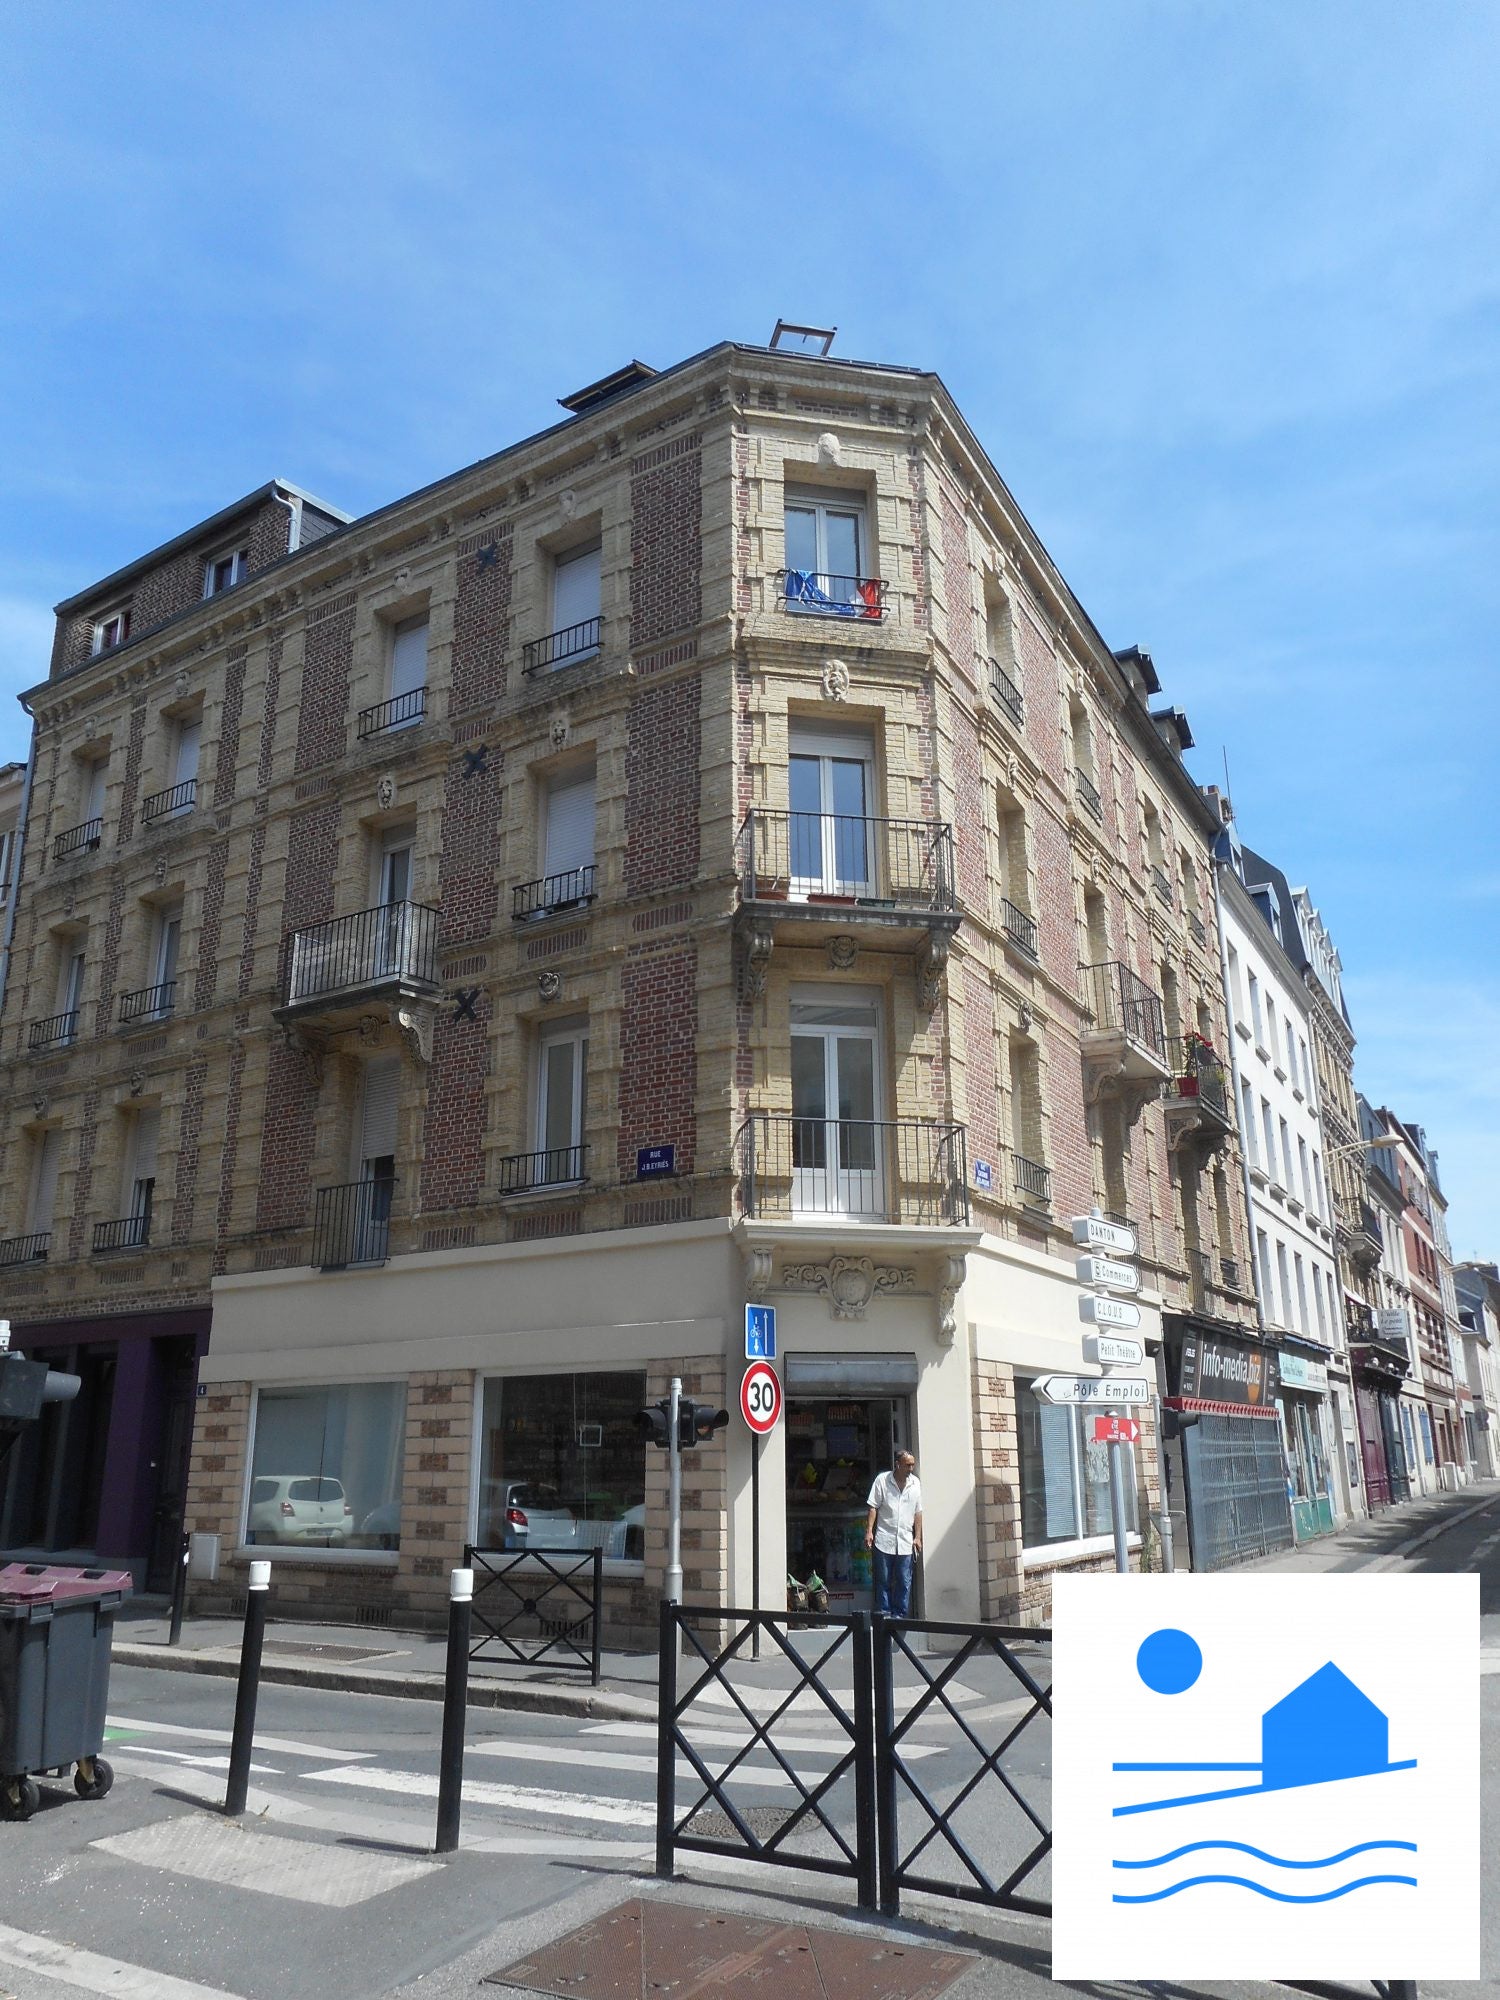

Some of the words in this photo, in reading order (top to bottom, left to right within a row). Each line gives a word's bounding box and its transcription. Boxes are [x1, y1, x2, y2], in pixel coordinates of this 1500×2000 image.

[1090, 1223, 1115, 1242] DANTON
[1102, 1265, 1133, 1284] Commerces
[1101, 1342, 1115, 1356] Petit
[1202, 1343, 1261, 1385] info-media.biz
[750, 1382, 774, 1412] 30
[1073, 1383, 1099, 1396] Pôle
[1105, 1384, 1145, 1399] Emploi
